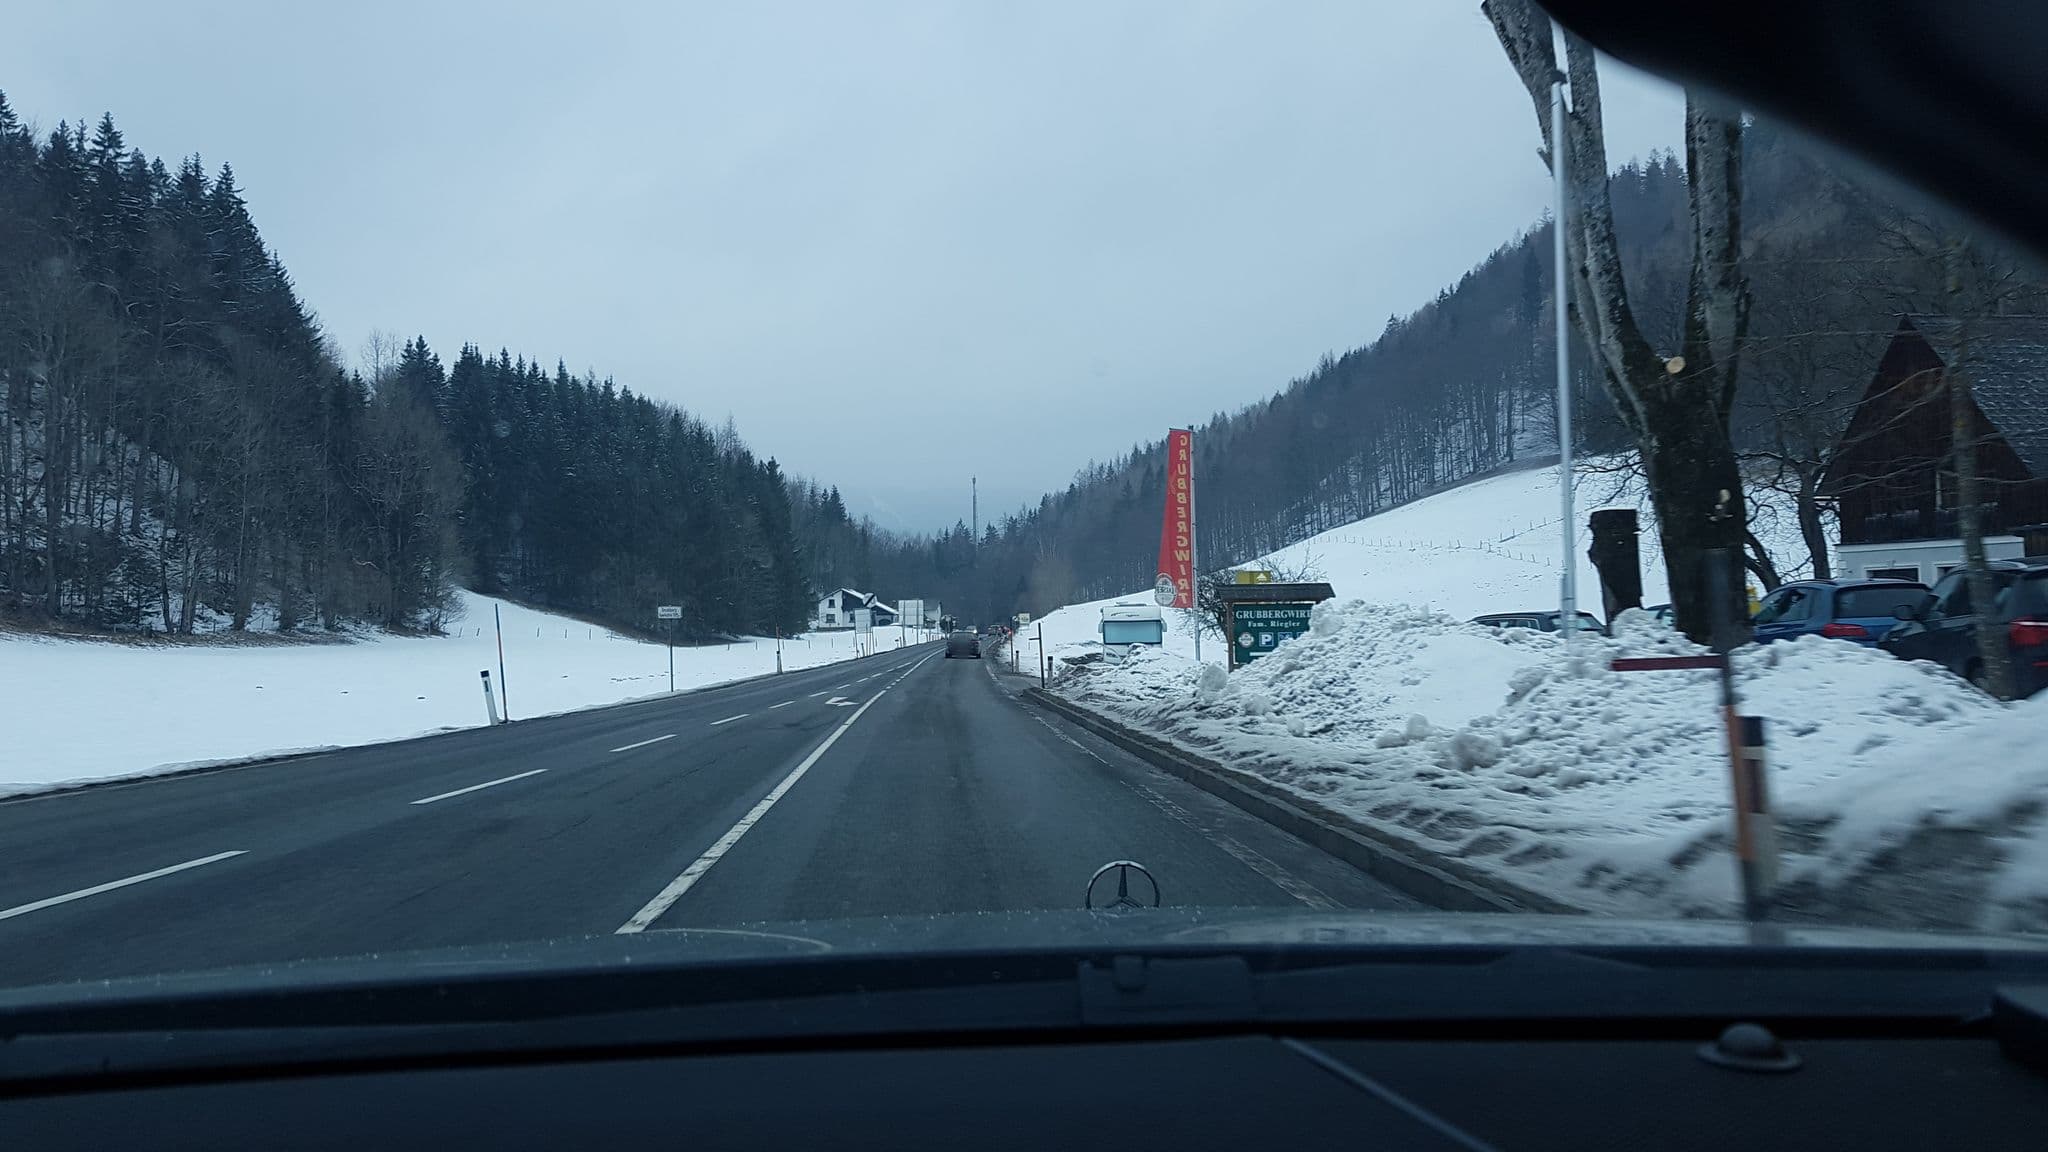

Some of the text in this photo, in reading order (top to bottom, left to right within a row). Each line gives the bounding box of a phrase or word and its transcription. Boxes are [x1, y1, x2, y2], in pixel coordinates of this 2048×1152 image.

[1248, 620, 1301, 629] Fam. Riegler
[1261, 634, 1272, 645] P
